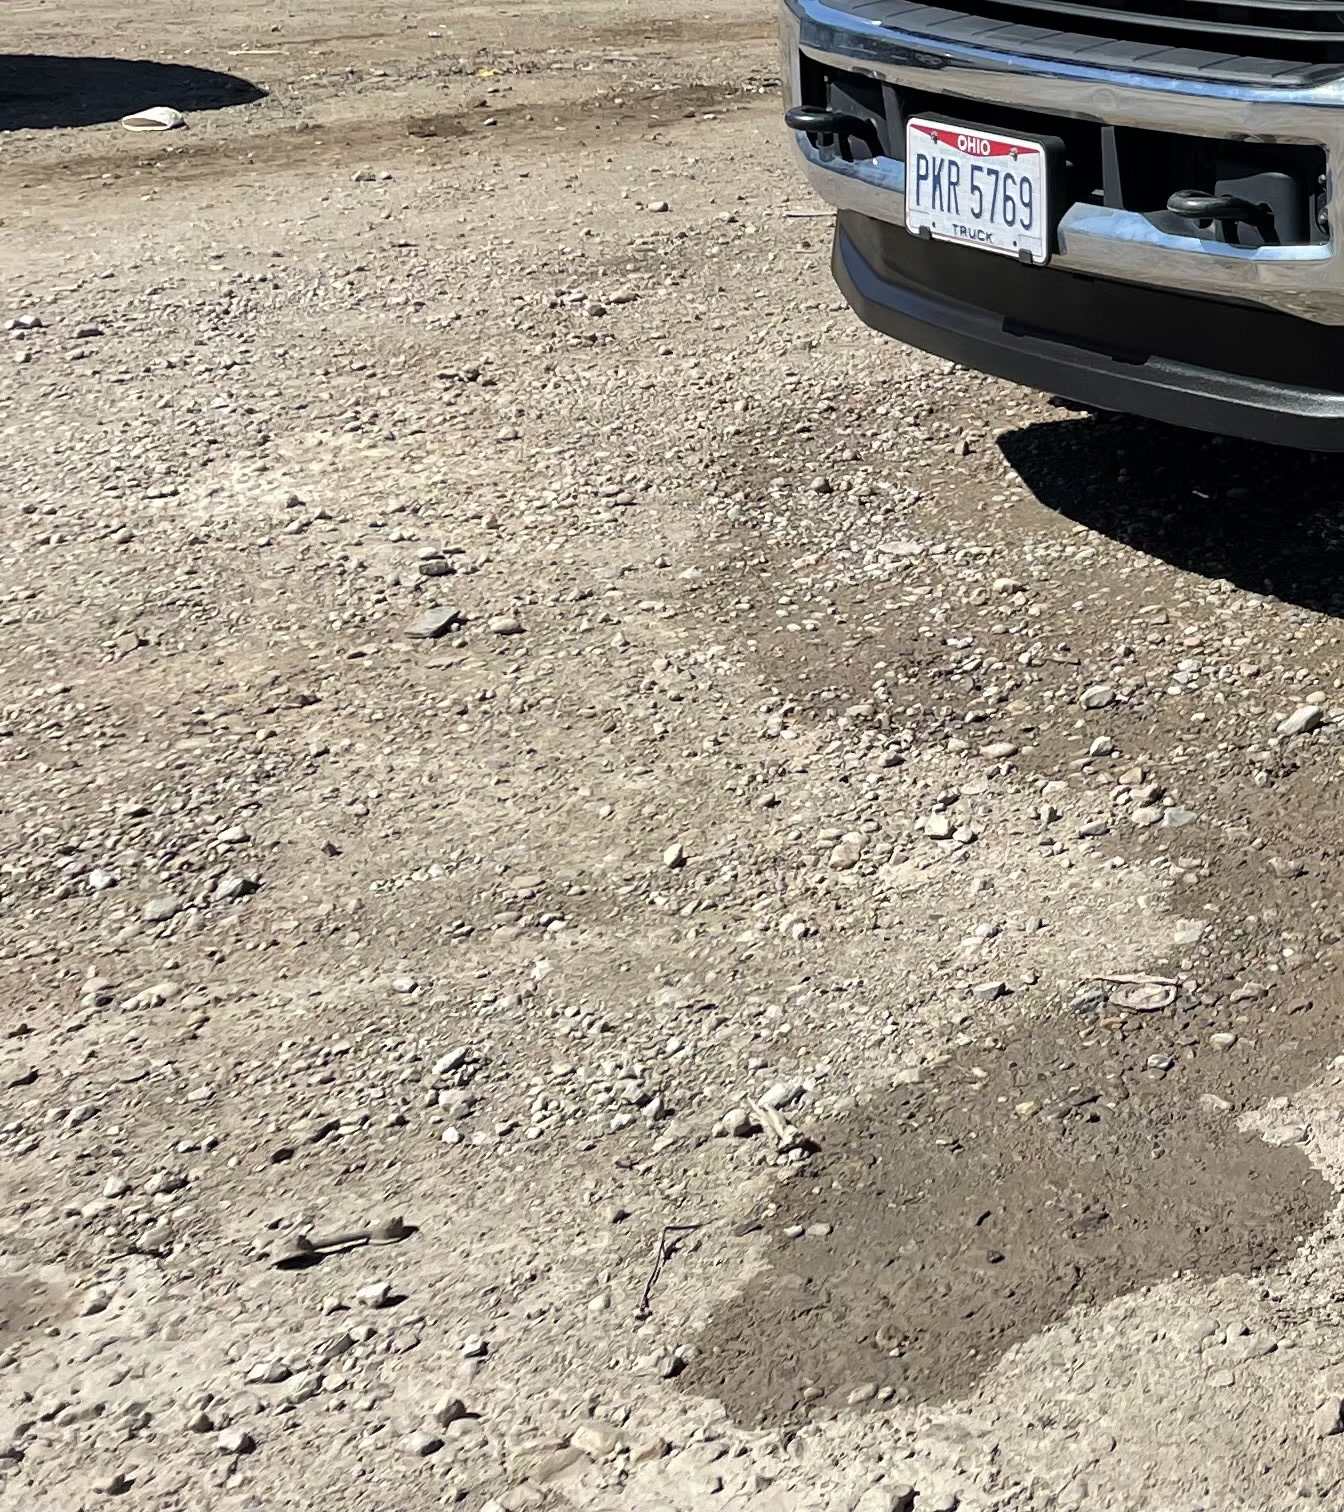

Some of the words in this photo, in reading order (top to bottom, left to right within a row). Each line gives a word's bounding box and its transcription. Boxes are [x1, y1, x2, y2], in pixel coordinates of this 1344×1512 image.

[957, 135, 991, 156] OHIO
[916, 153, 961, 216] PKR
[970, 163, 1033, 230] 5769
[952, 223, 993, 244] TRUCK
